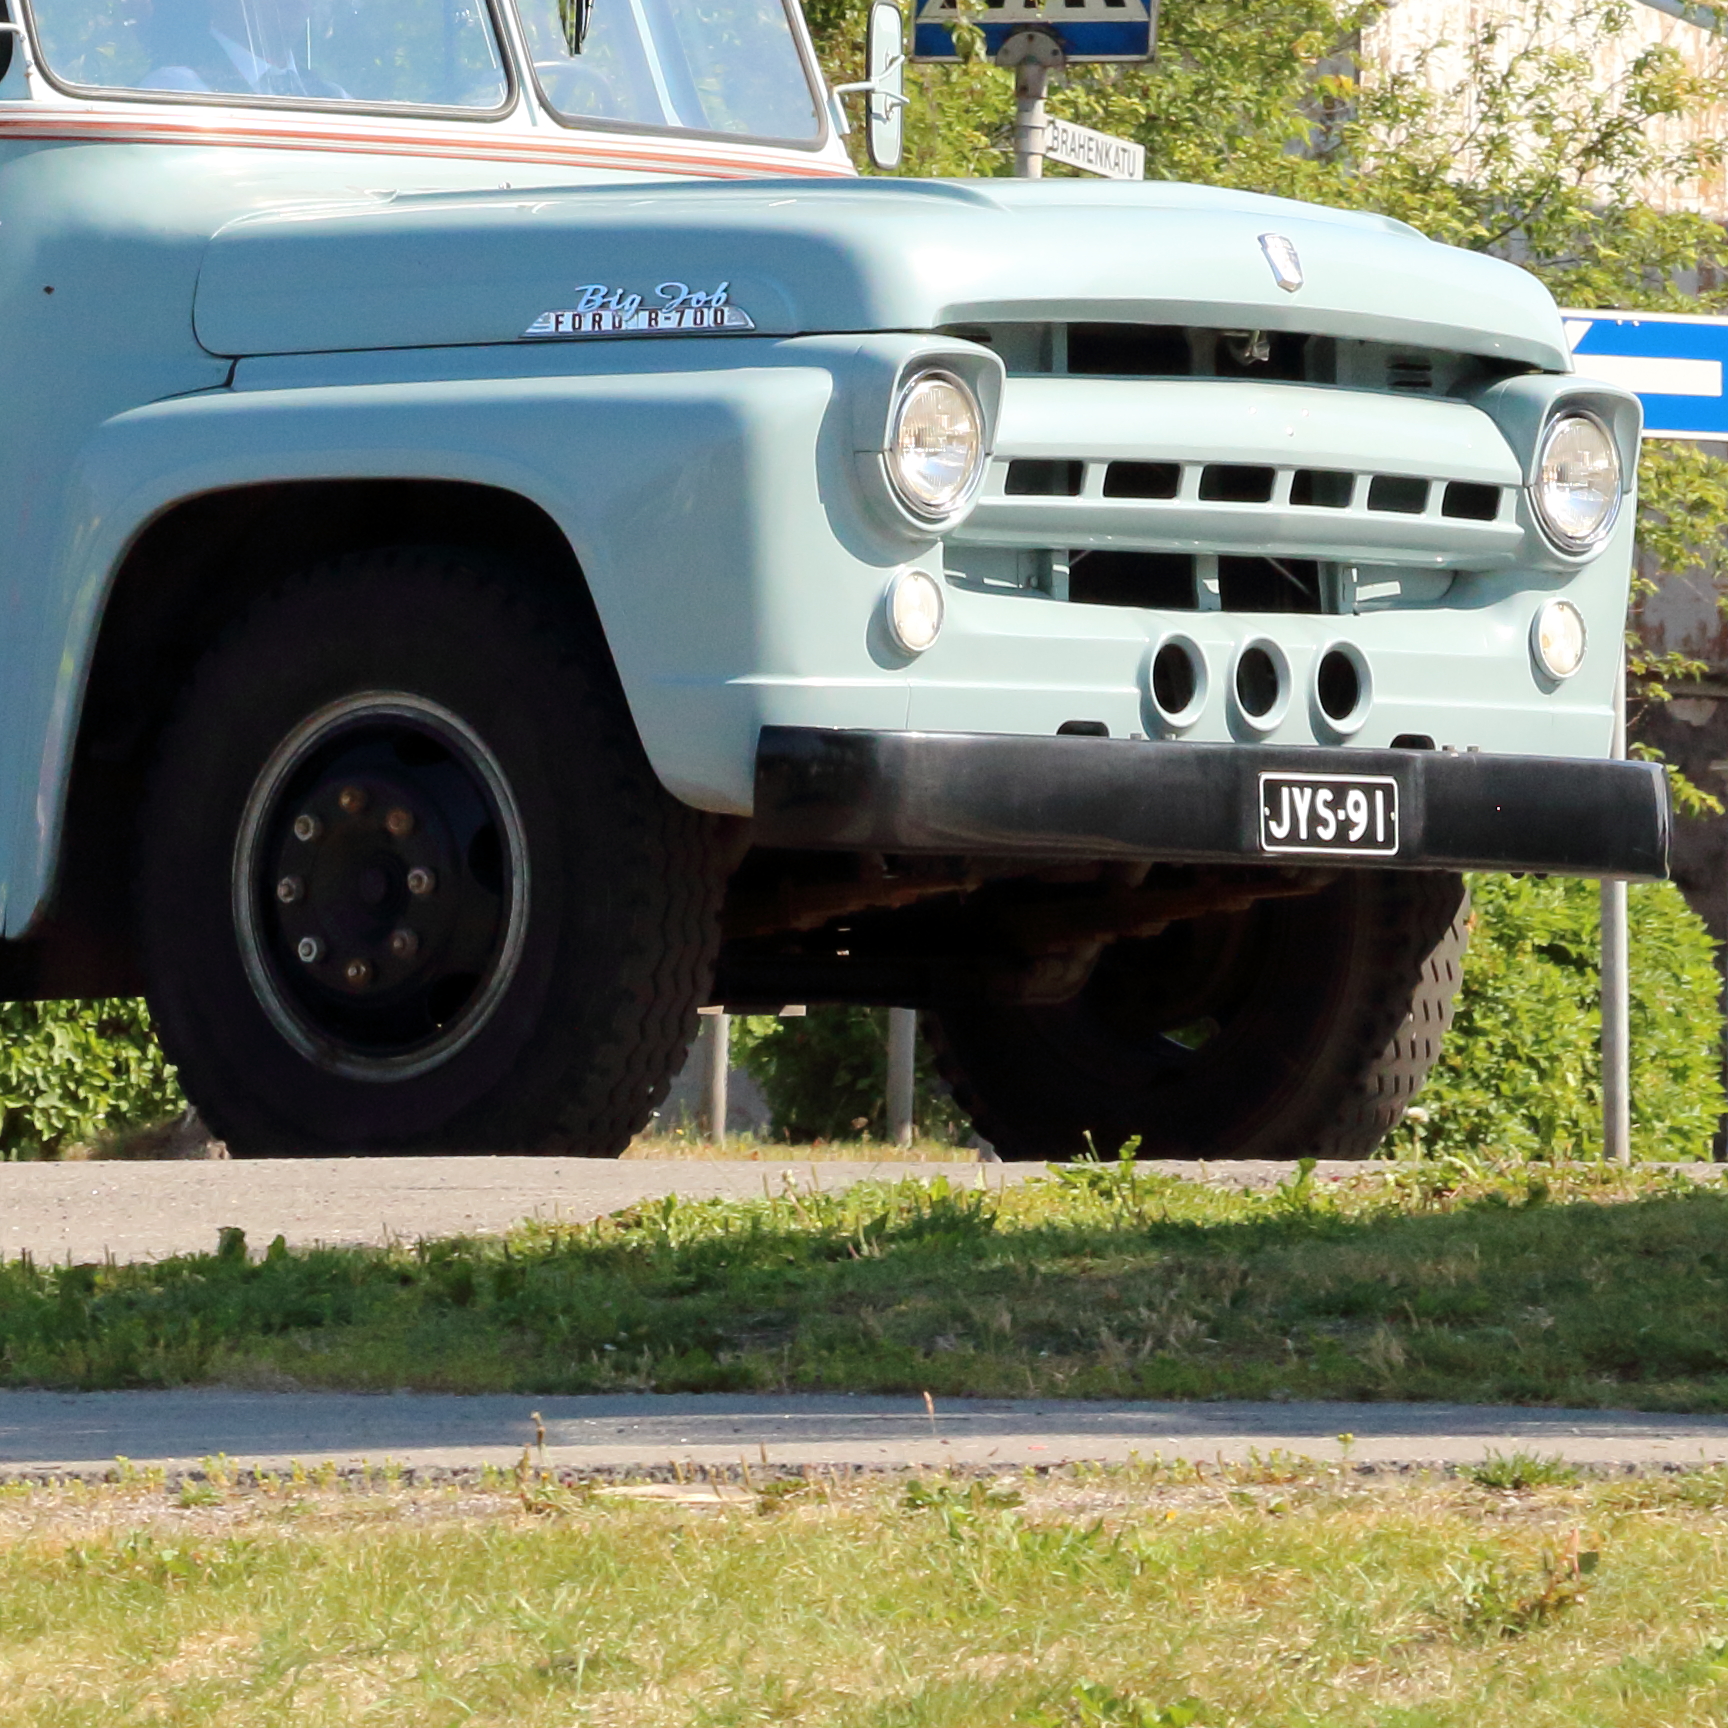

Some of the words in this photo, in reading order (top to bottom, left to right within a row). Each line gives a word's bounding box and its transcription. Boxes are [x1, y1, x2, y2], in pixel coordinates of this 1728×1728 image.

[1052, 125, 1137, 178] BRAHENKATU
[554, 313, 623, 332] FORD
[575, 283, 642, 321] Big
[655, 281, 730, 314] Job
[1269, 786, 1385, 842] JYS-91
